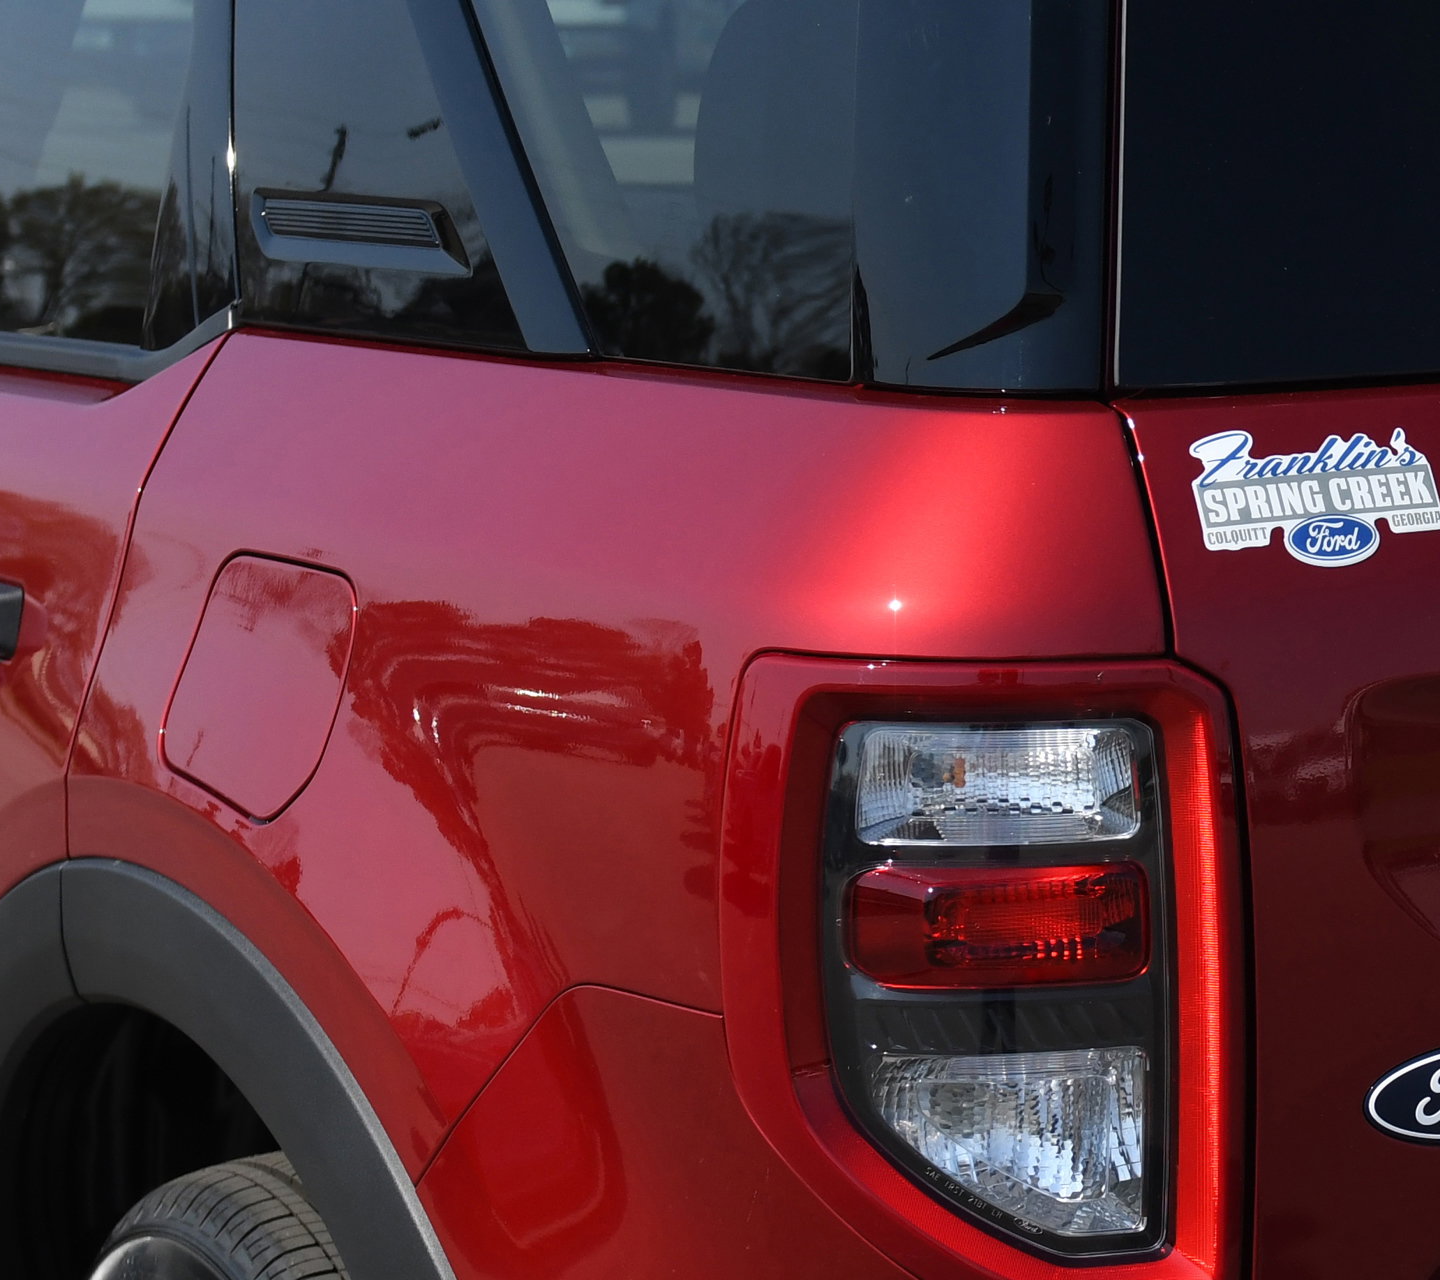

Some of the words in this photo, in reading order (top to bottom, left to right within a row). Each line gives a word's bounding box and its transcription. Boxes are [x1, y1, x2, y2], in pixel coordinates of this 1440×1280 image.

[1193, 430, 1422, 488] Franklin's
[1203, 480, 1326, 523] SPRING
[1328, 471, 1433, 513] CREEK
[1207, 526, 1267, 546] COLQUITT
[1306, 521, 1360, 553] Ford
